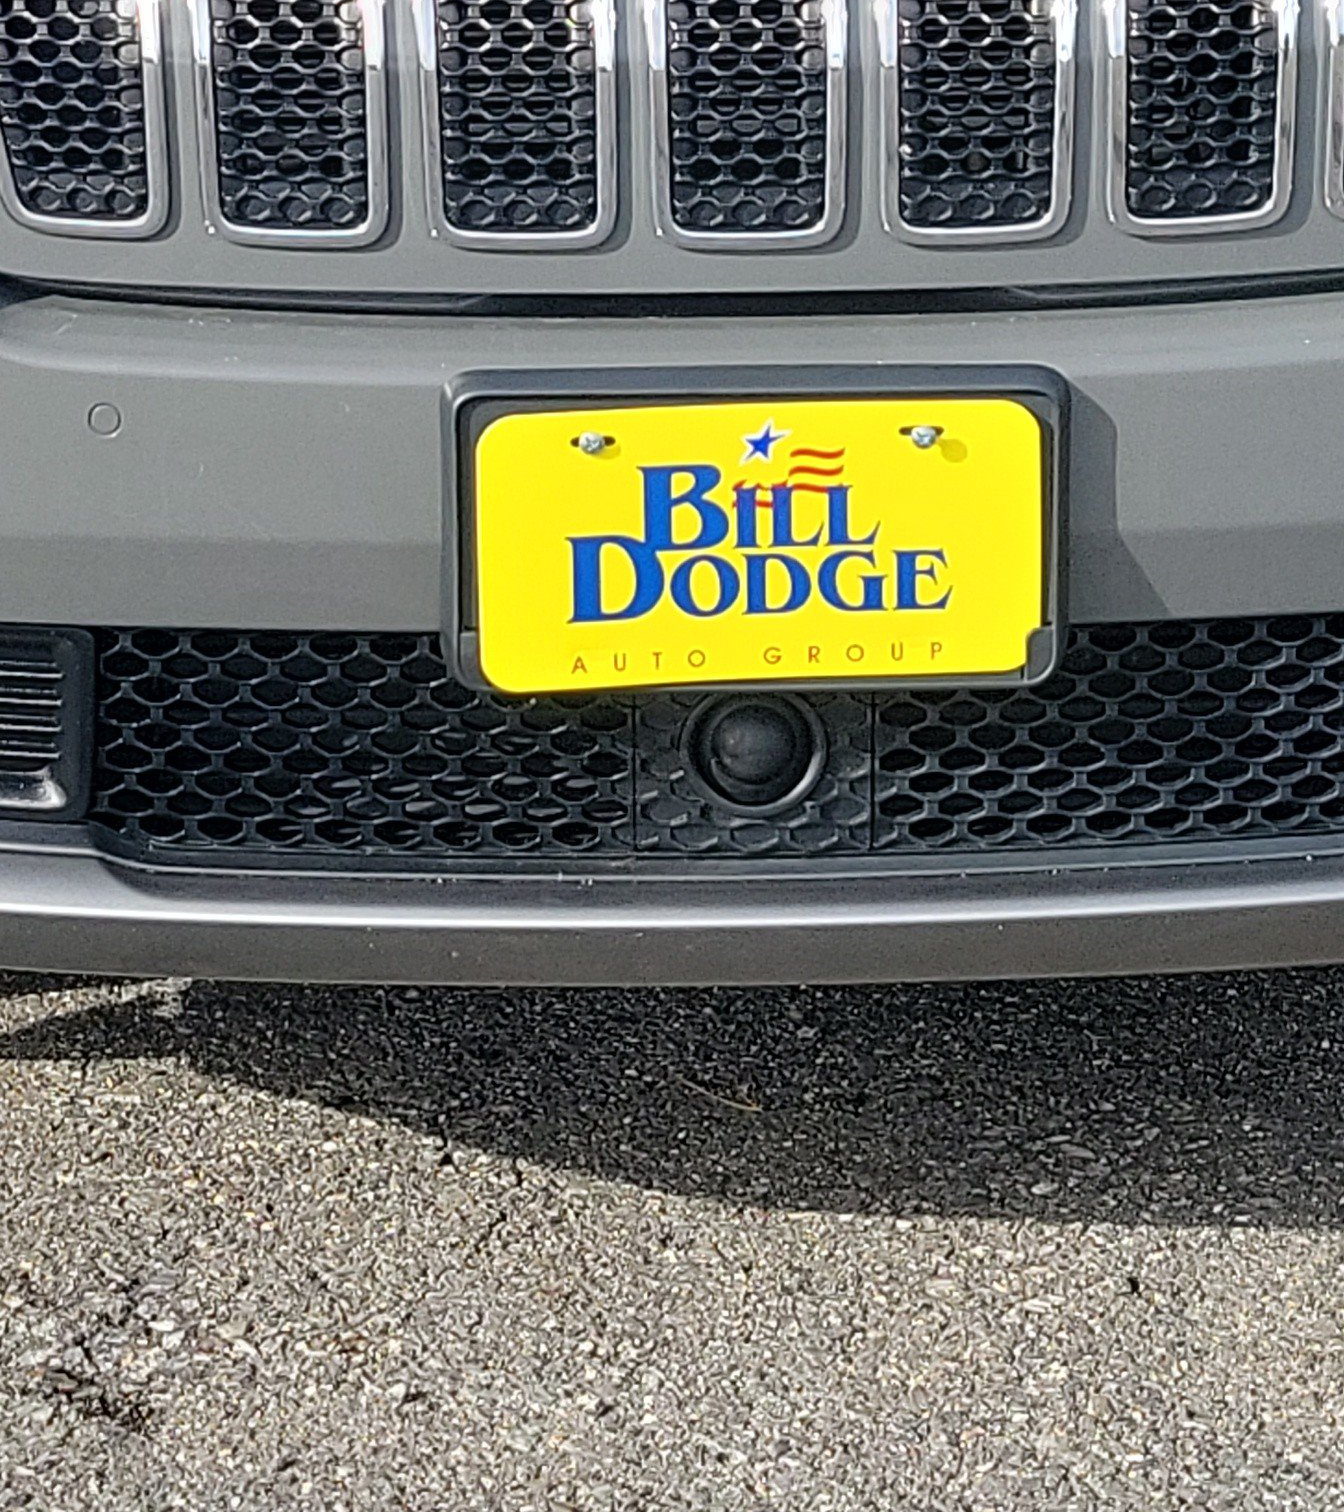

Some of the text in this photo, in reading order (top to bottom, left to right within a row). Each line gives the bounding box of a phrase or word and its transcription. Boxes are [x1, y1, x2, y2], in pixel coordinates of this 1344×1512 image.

[636, 464, 880, 552] BILL
[565, 535, 954, 624] DODGE
[571, 641, 945, 675] AUTO GROUP
